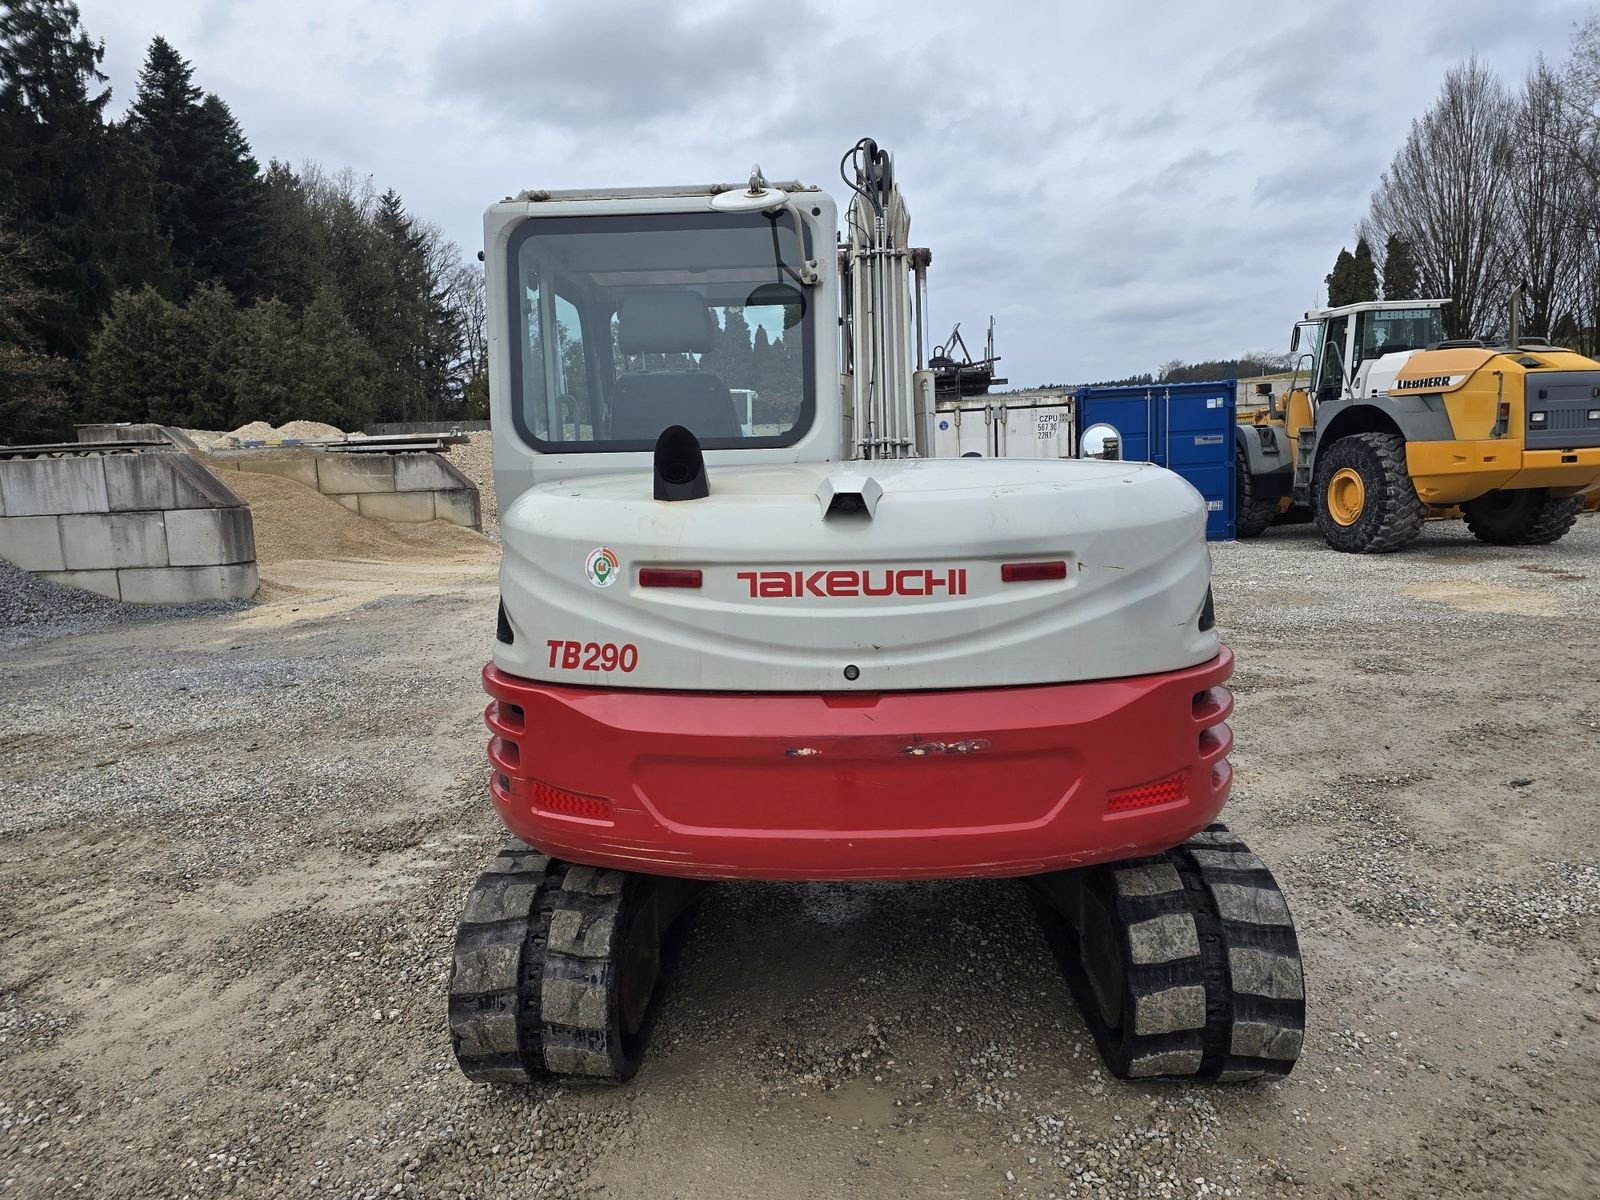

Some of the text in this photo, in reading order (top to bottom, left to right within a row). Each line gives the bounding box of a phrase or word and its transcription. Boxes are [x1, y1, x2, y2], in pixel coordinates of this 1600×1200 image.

[1375, 310, 1431, 320] LIEBHERR
[1397, 376, 1451, 389] LIEBHERR
[736, 569, 967, 598] TAKEUCHI
[547, 639, 638, 673] TB290
